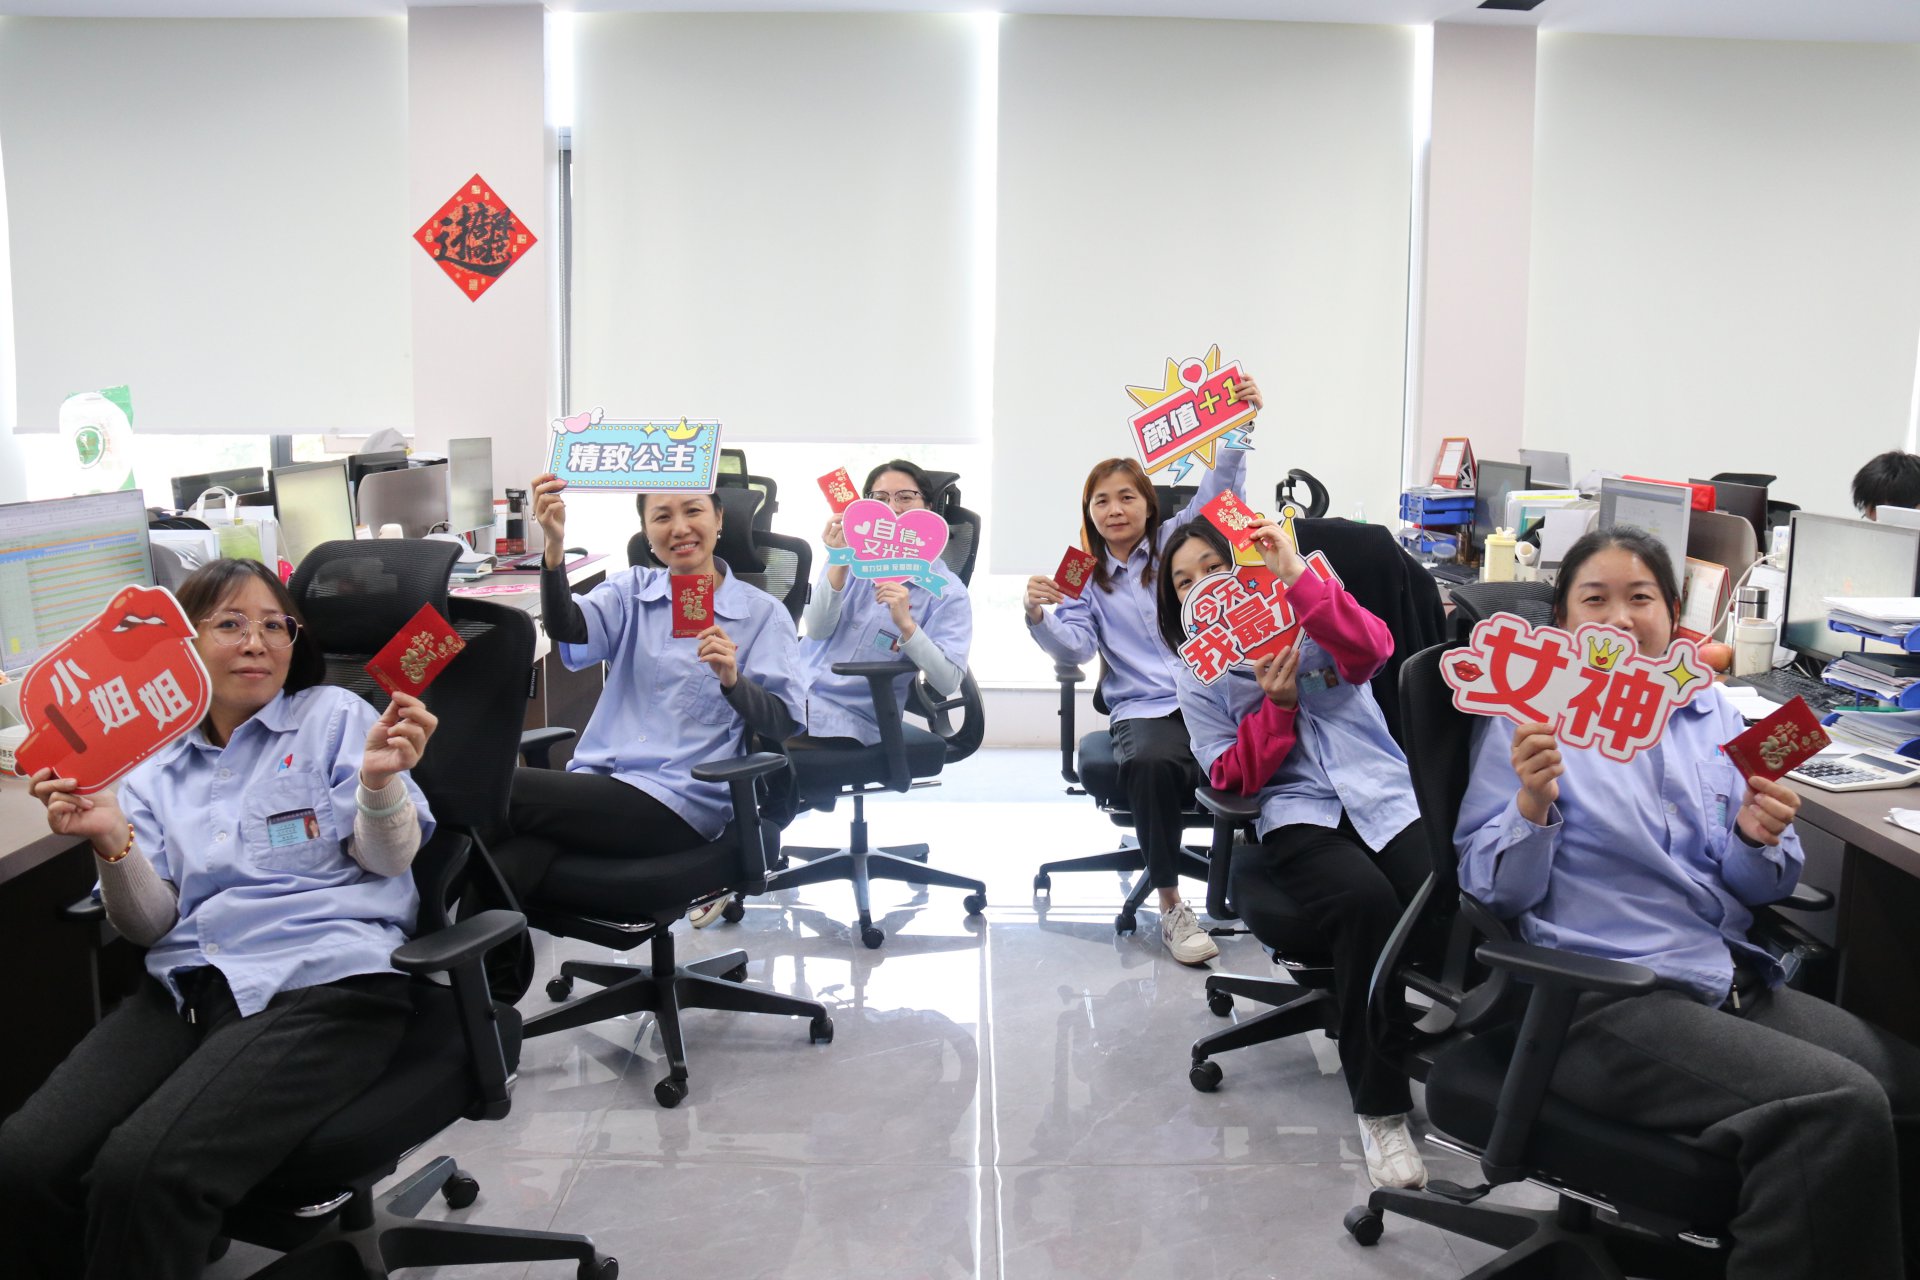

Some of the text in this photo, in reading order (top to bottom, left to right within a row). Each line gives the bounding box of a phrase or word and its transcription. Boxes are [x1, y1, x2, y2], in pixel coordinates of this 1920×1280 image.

[567, 442, 697, 473] 精致公主
[862, 538, 919, 559] 又光芒
[873, 518, 917, 545] 自信
[1194, 580, 1249, 622] 今天
[49, 658, 193, 735] 小姐姐
[1467, 625, 1664, 750] 女神
